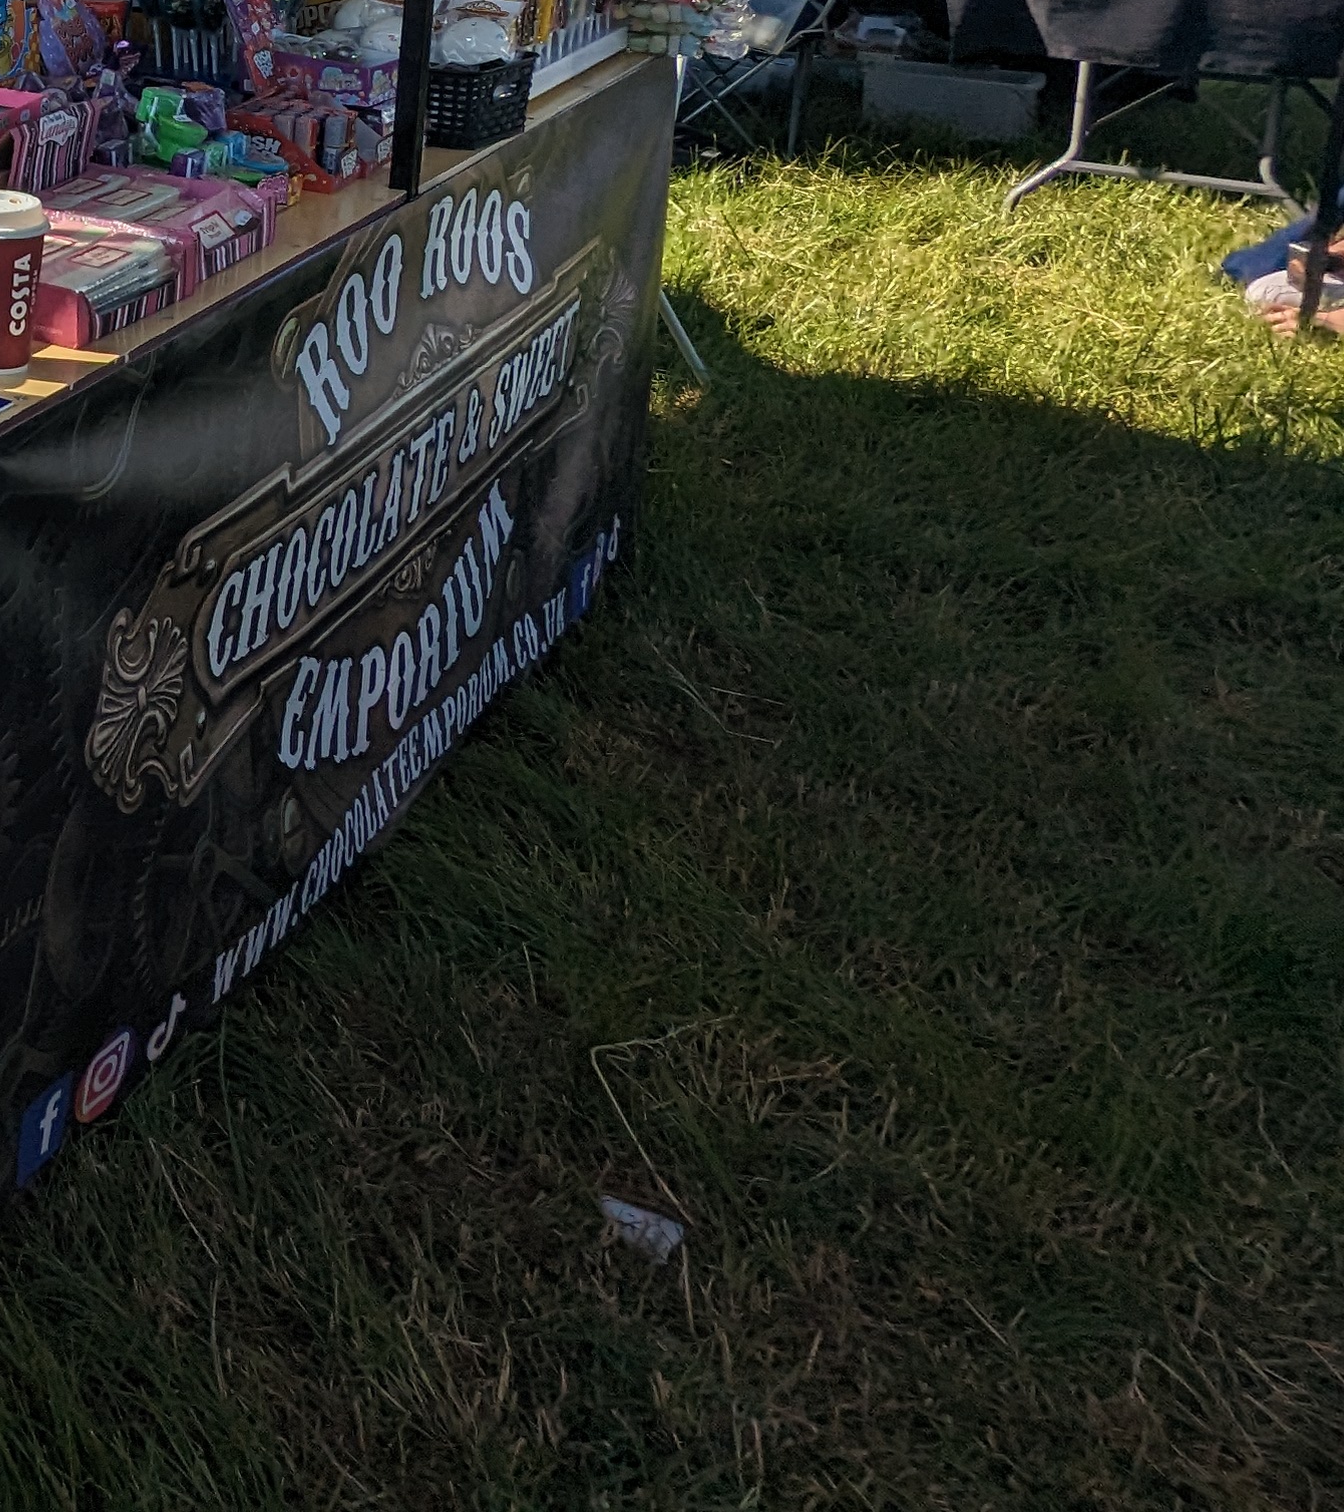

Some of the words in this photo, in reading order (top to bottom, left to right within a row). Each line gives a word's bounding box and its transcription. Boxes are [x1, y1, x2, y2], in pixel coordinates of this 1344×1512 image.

[9, 253, 32, 336] COSTA
[295, 234, 403, 446] ROO
[420, 188, 534, 300] ROOS
[207, 408, 455, 677] CHOCOLATE
[459, 389, 484, 464] &
[488, 300, 581, 449] SWEET
[278, 478, 514, 771] EMPORIUM
[212, 587, 567, 1004] WWW.CHOCOLATEEMPORIUM.CO.UK
